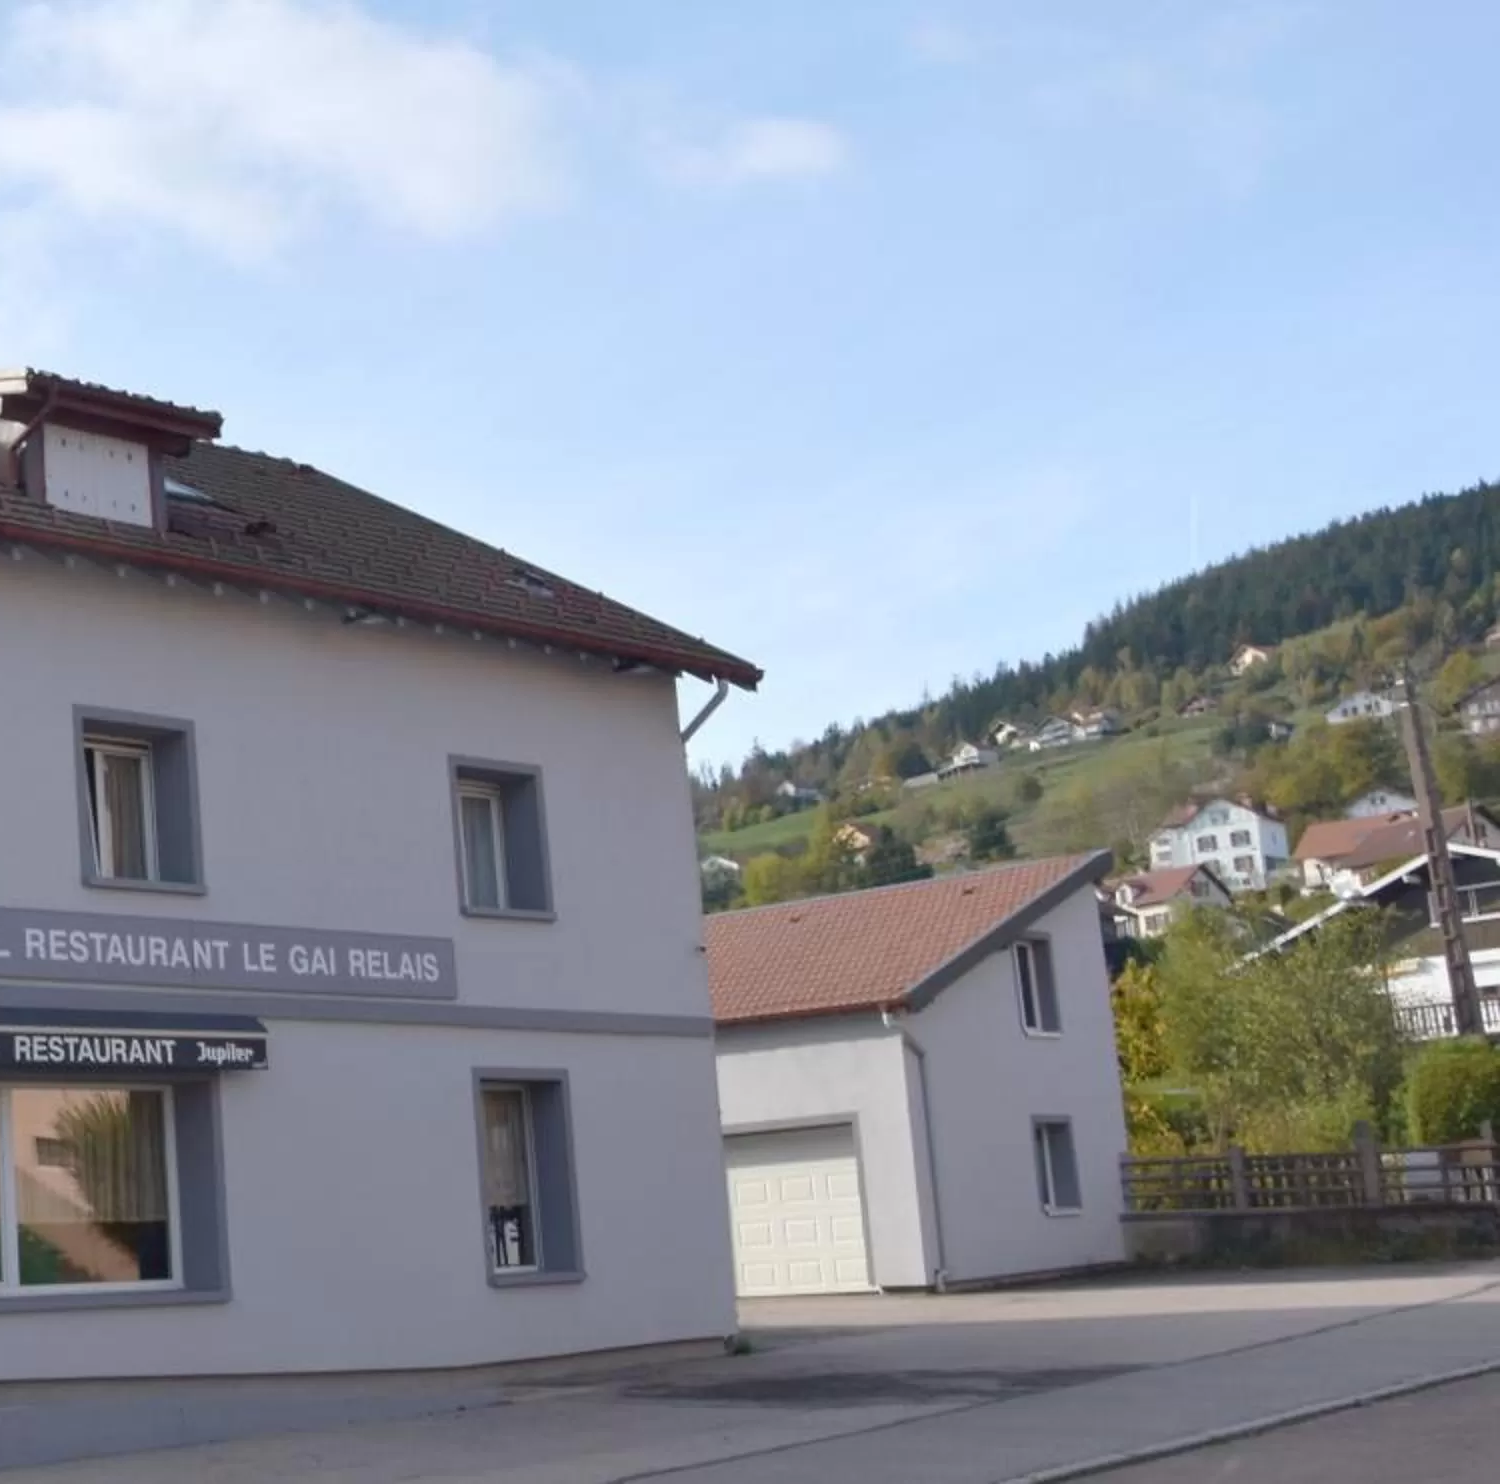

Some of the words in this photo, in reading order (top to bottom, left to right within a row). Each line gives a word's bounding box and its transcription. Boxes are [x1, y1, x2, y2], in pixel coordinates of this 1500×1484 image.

[25, 927, 229, 972] RESTAURANT
[242, 943, 277, 973] LE
[288, 945, 336, 976] GAI
[348, 949, 440, 983] RELAIS
[14, 1037, 177, 1065] RESTAURANT
[196, 1041, 254, 1065] Jupiler
